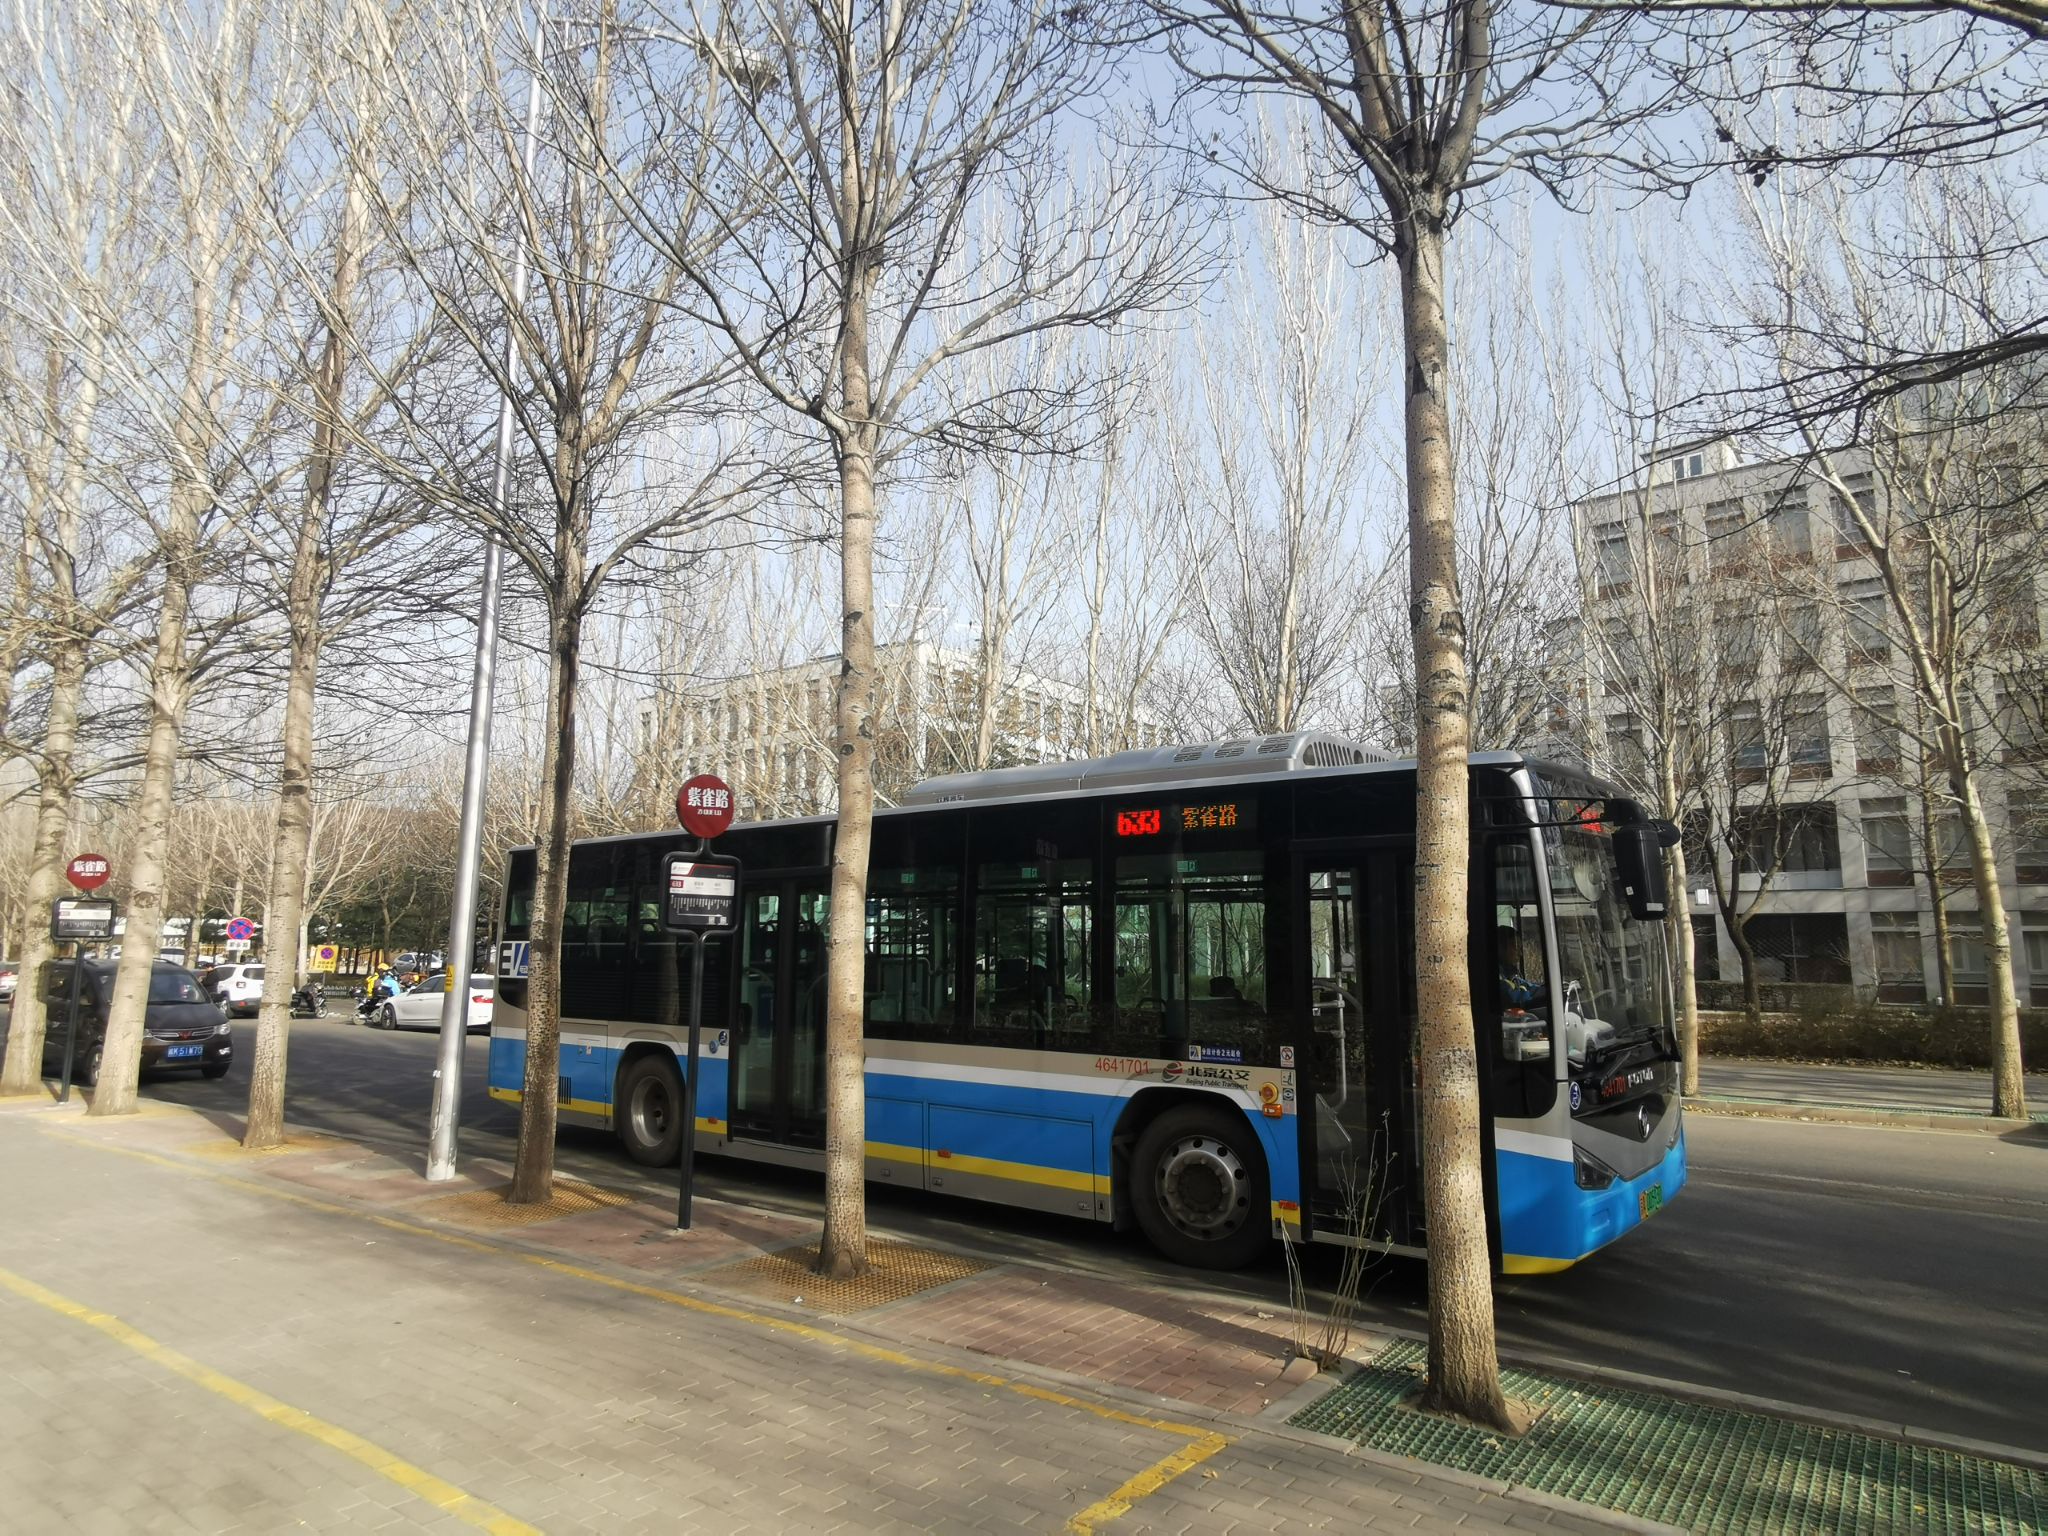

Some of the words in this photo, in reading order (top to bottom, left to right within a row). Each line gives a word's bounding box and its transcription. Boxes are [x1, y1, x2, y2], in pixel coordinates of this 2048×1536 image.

[688, 787, 729, 808] 紫雀路
[1118, 810, 1160, 836] 633
[1182, 804, 1238, 828] 紫雀路
[1095, 1057, 1150, 1075] 4641701
[1187, 1066, 1250, 1081] 北京公交
[1185, 1078, 1205, 1087] Beijing
[1205, 1079, 1223, 1088] Public
[1222, 1080, 1249, 1090] Transport
